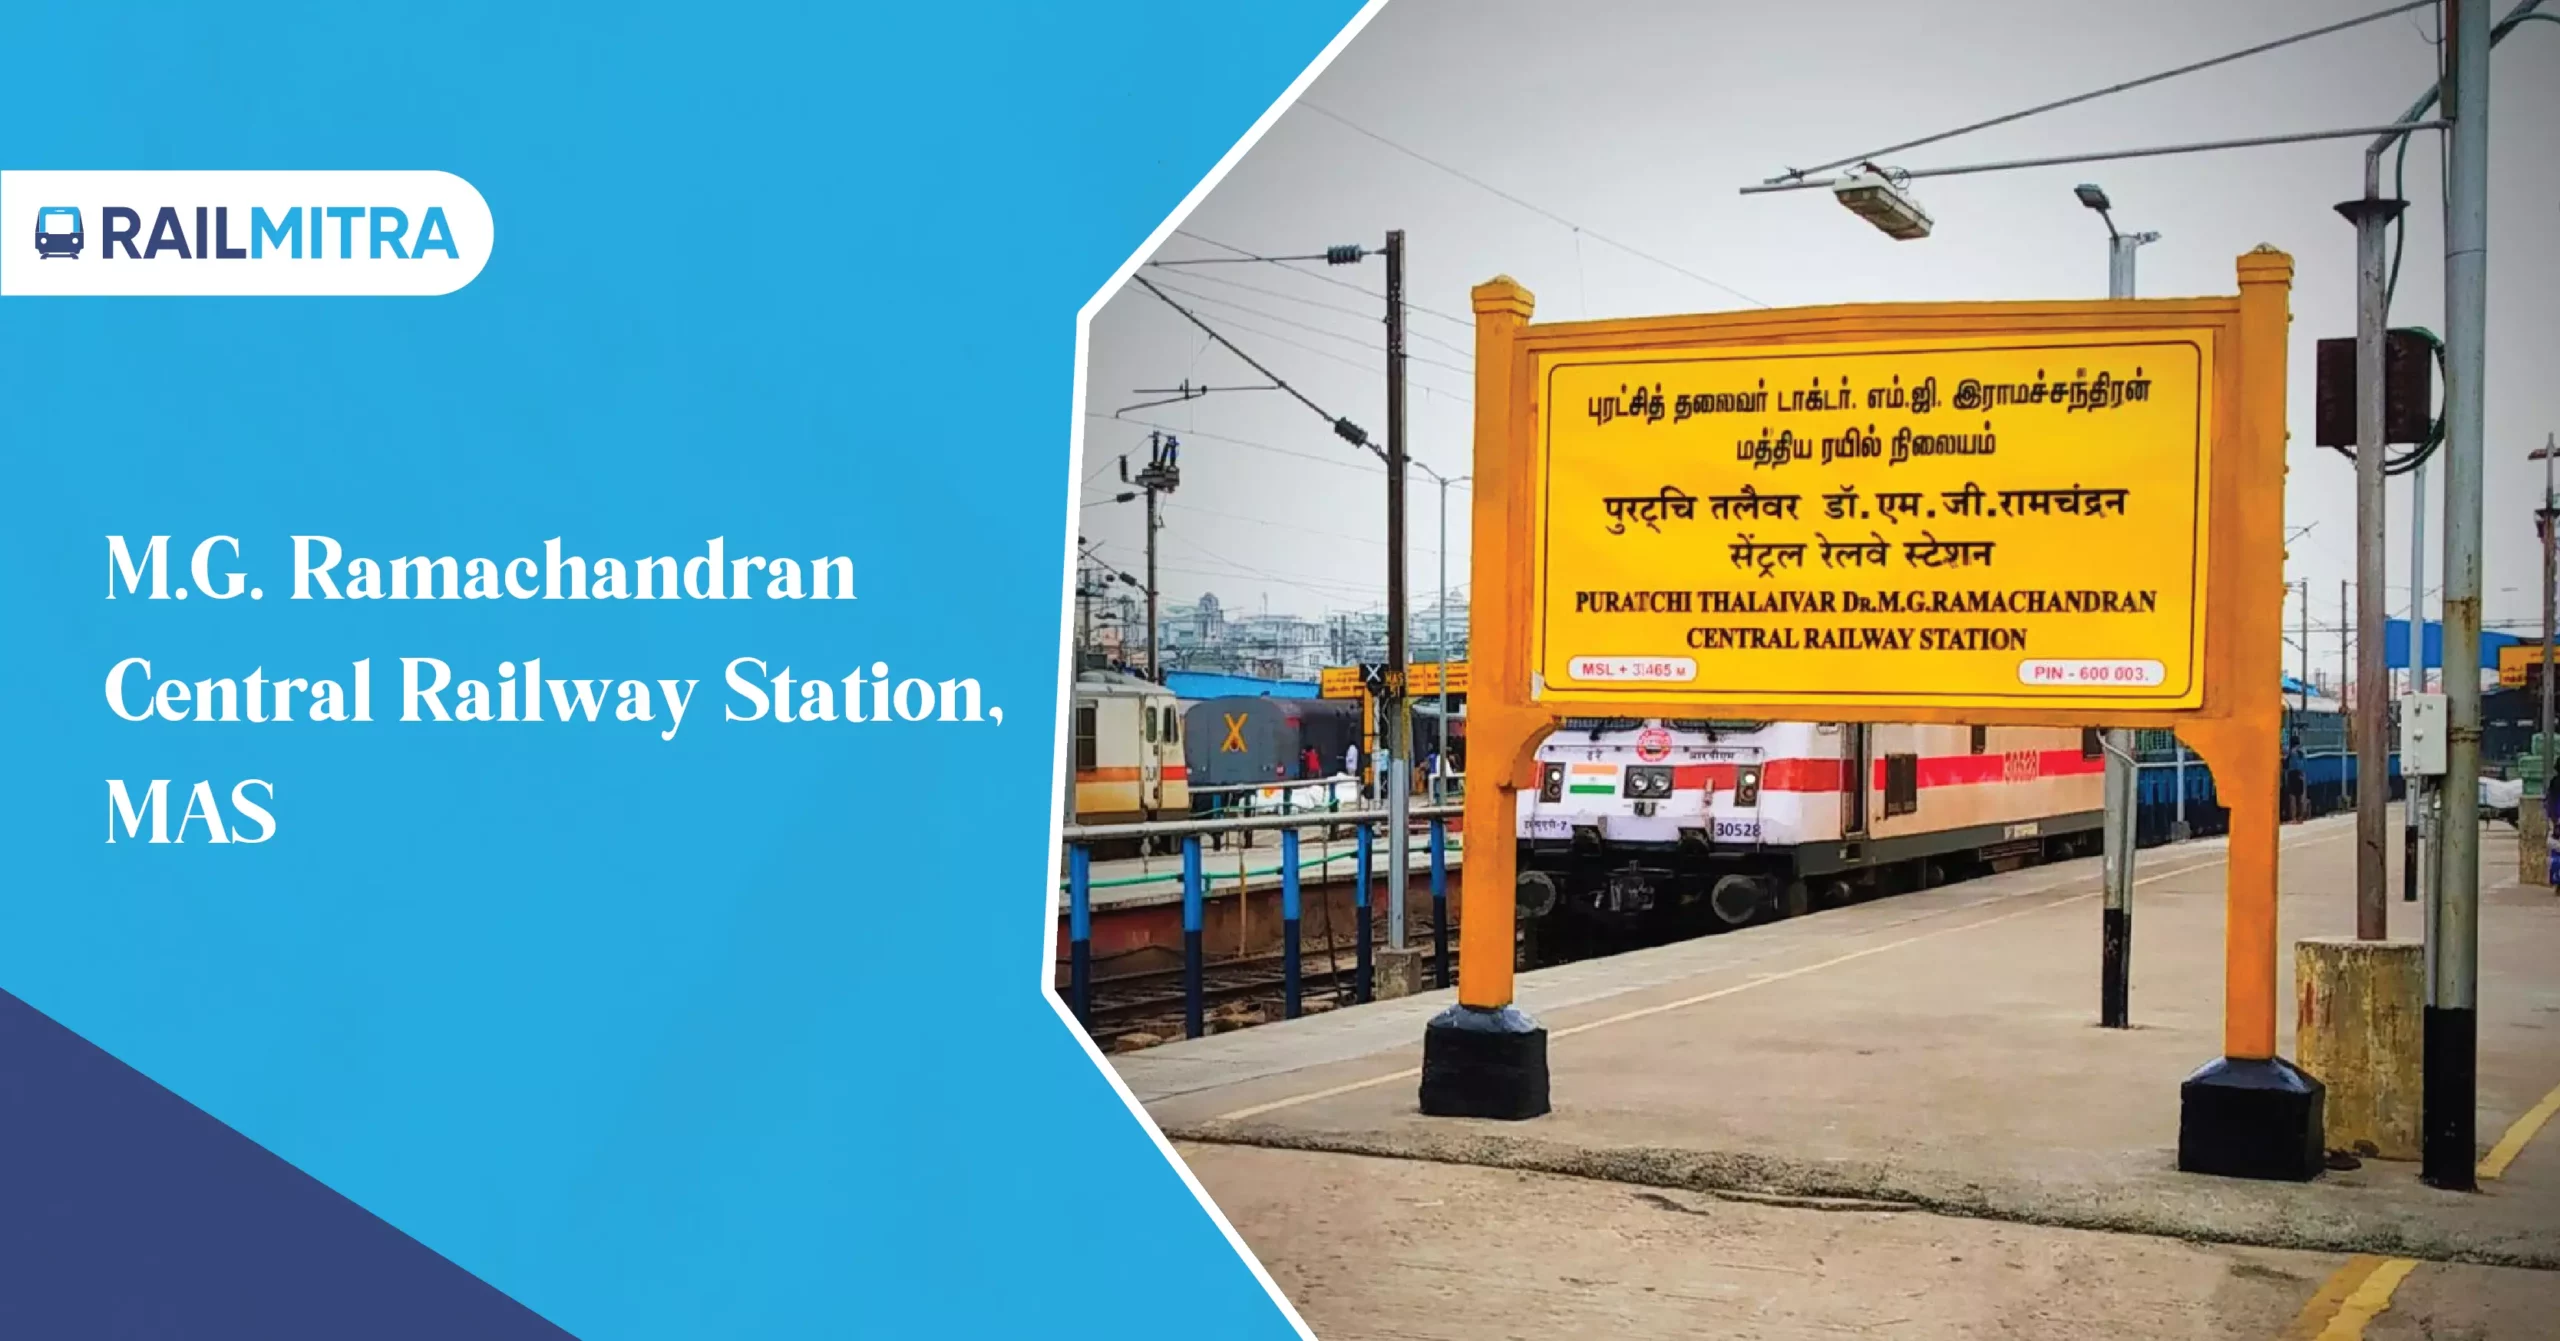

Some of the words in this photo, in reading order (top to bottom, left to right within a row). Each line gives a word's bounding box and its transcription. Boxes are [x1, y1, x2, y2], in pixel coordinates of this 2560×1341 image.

[1588, 383, 1665, 425] புரட்சித்
[1674, 378, 1768, 424] தலைவர்
[1953, 366, 2152, 412] இராமச்சந்திரன்
[1737, 427, 1812, 468] மத்திய
[1822, 424, 1882, 465] ரயில்
[1889, 420, 1996, 466] நிலையம்
[1709, 483, 1802, 521] तलैवर
[1728, 532, 1808, 578] सेंट्रल
[1814, 531, 1891, 568] रेलवे
[1903, 530, 1996, 569] स्टेशन
[1576, 590, 1693, 613] PURATCHI
[1699, 590, 1836, 613] THALAIVAR
[1686, 627, 1799, 649] CENTRAL
[1803, 627, 1916, 649] RAILWAY
[1919, 627, 2027, 650] STATION
[1582, 662, 1615, 677] MSL
[2034, 665, 2064, 680] PIN
[2079, 665, 2111, 681] 600
[1716, 822, 1761, 837] 30528
